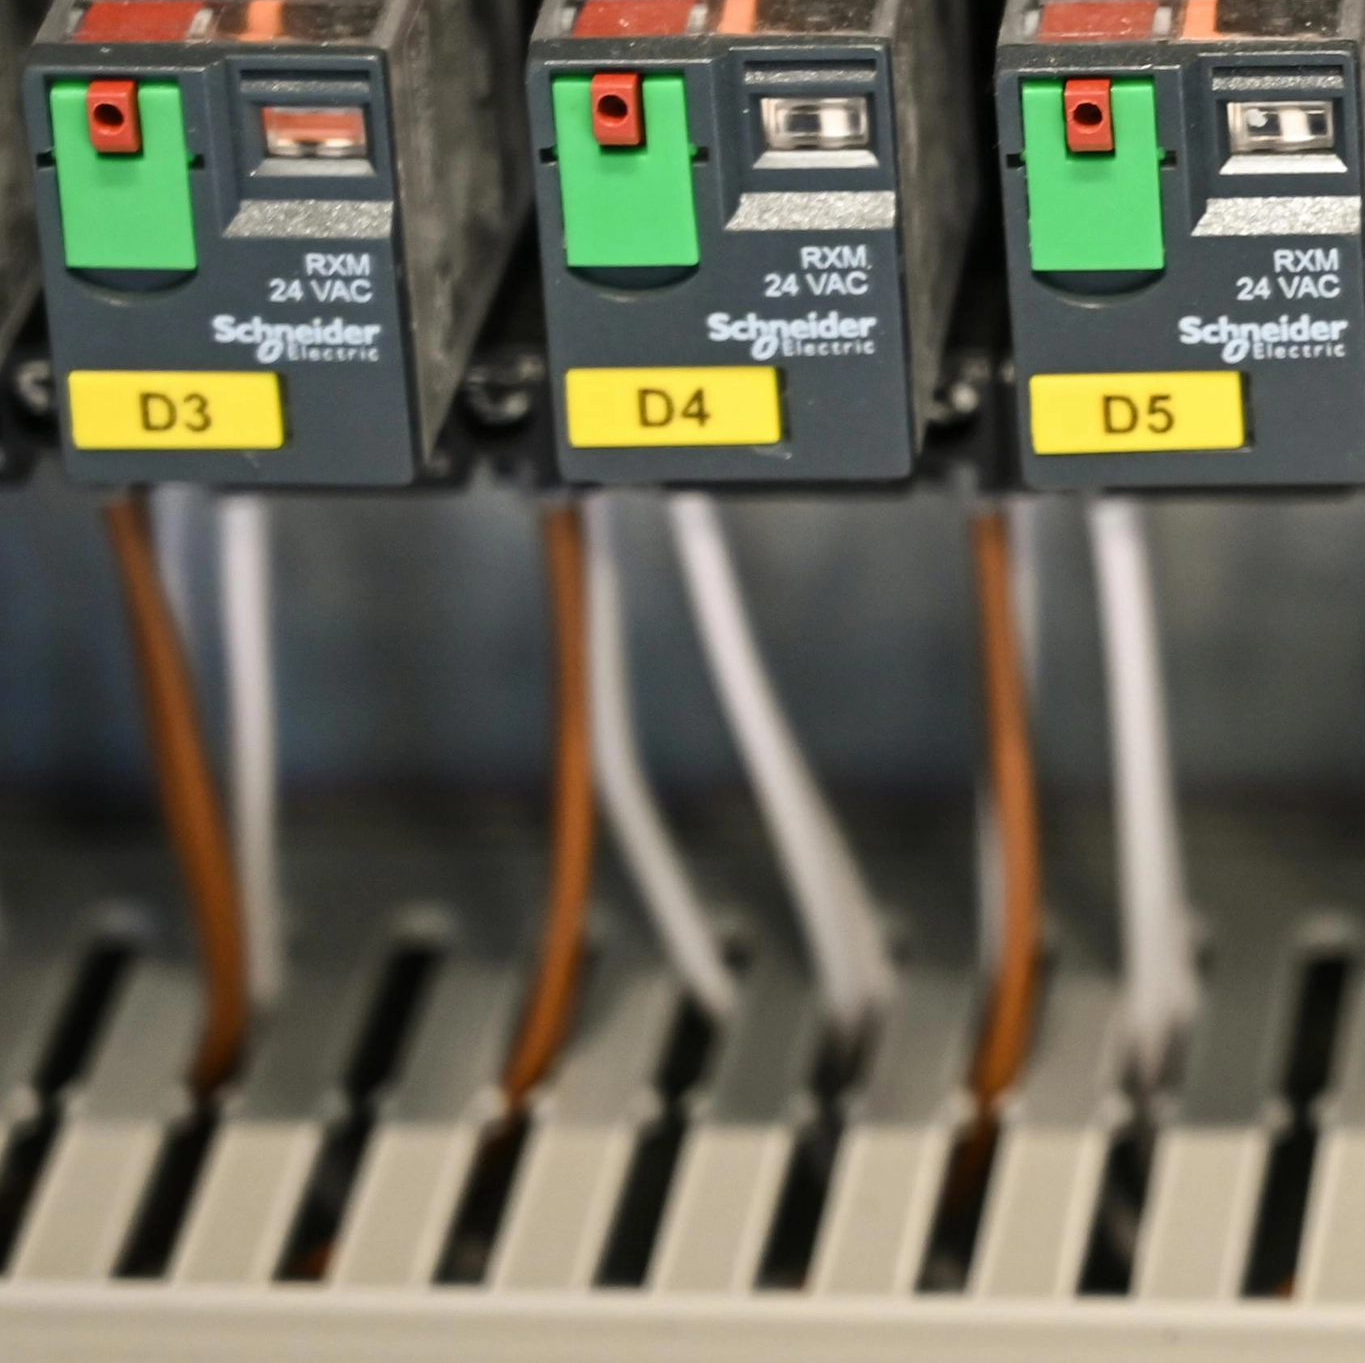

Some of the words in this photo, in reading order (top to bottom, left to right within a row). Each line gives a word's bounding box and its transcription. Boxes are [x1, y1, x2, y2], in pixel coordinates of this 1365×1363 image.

[305, 253, 370, 276] RXM
[800, 244, 867, 269] RXM
[1273, 248, 1339, 273] RXM
[269, 278, 304, 302] 24
[310, 278, 373, 304] VAC
[764, 273, 800, 298] 24
[805, 270, 869, 296] VAC
[1236, 276, 1272, 301] 24
[1277, 273, 1341, 299] VAC
[212, 315, 381, 344] Schneider
[707, 312, 877, 341] Schneider
[1178, 315, 1348, 344] Schneider
[1253, 343, 1346, 359] Electric
[138, 391, 212, 433] D3
[637, 387, 711, 428] D4
[1101, 393, 1175, 435] D5
